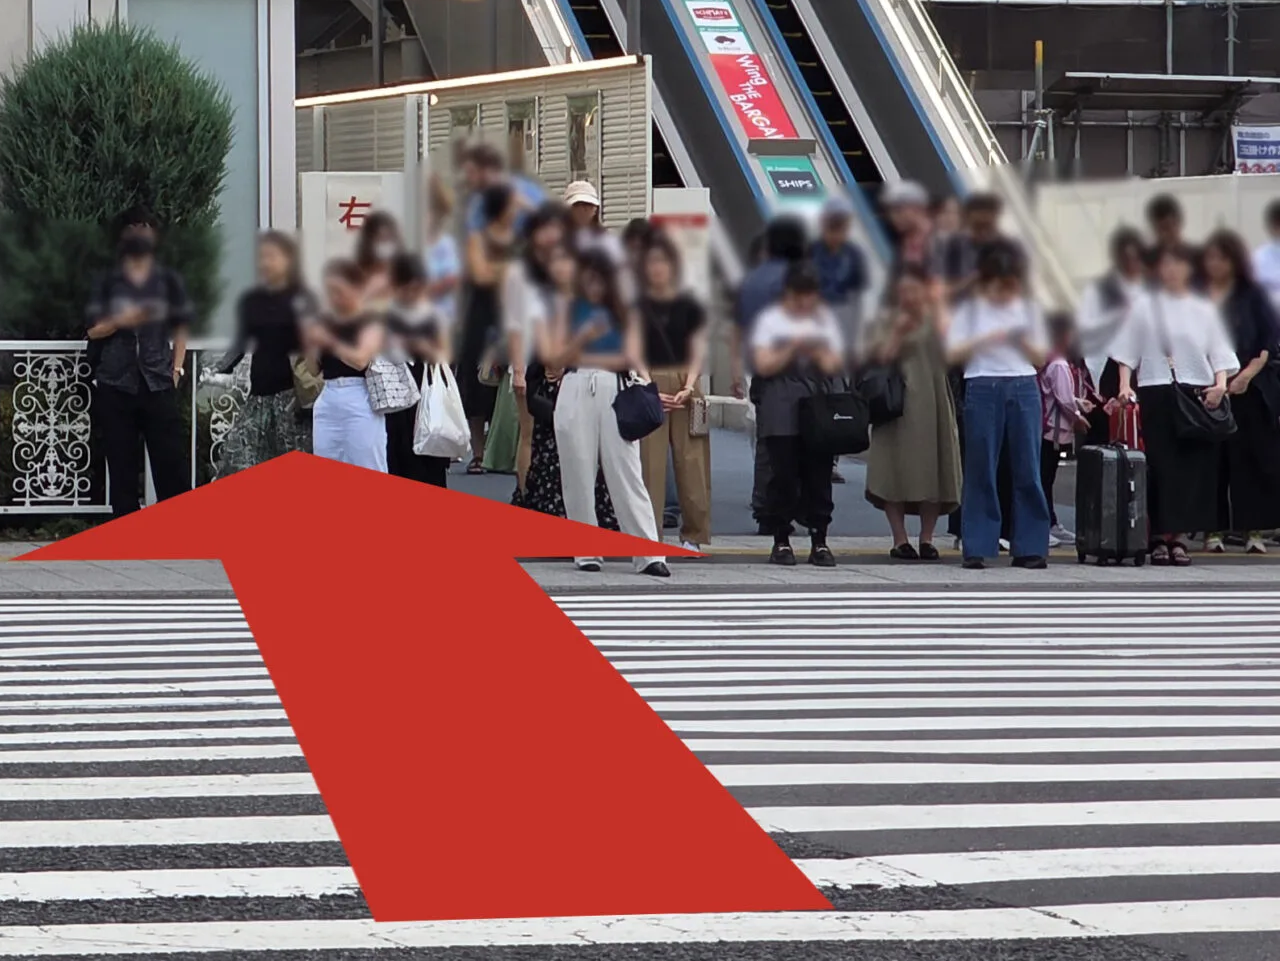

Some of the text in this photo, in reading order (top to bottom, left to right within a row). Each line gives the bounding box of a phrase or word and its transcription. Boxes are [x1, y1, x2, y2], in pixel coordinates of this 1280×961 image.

[736, 53, 768, 86] Wing
[738, 81, 762, 100] THE
[777, 179, 813, 188] SHIPS
